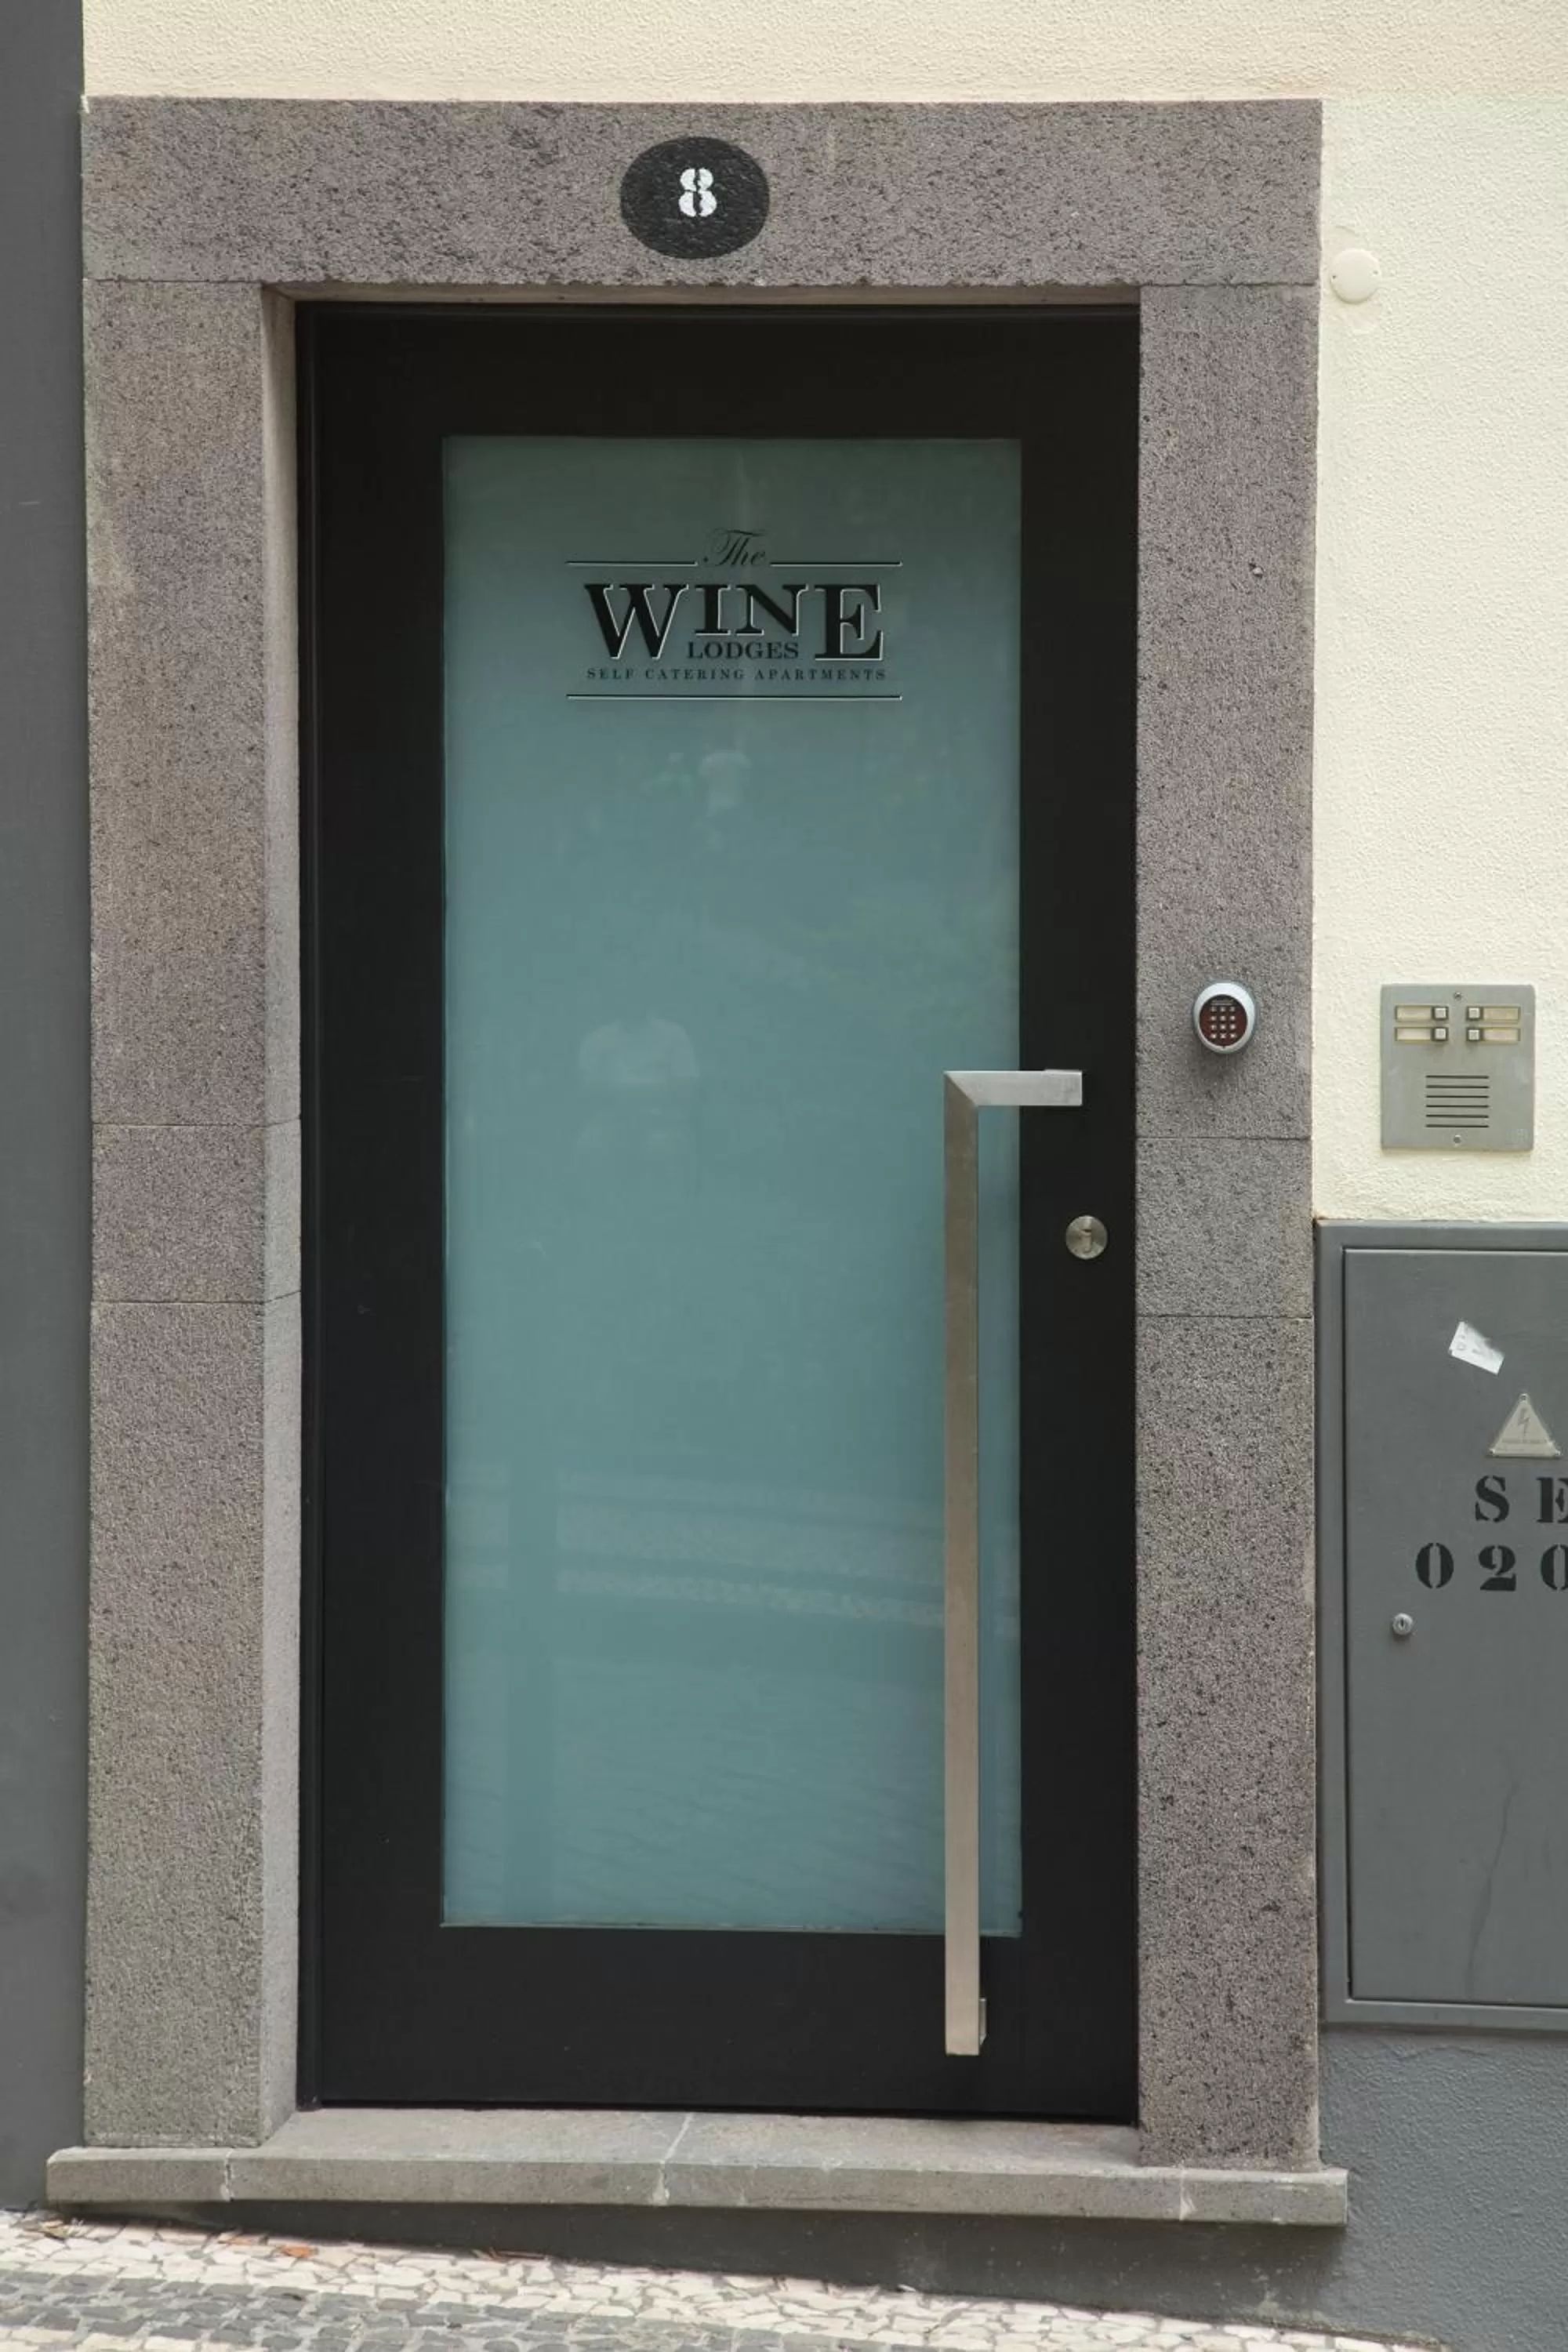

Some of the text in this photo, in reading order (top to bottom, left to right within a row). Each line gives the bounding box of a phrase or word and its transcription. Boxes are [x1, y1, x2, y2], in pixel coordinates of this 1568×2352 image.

[678, 168, 717, 217] 8
[704, 528, 766, 567] The
[584, 583, 884, 662] WINE
[687, 641, 799, 660] LODGES
[586, 667, 886, 681] SELF CATERING APARTMENTS
